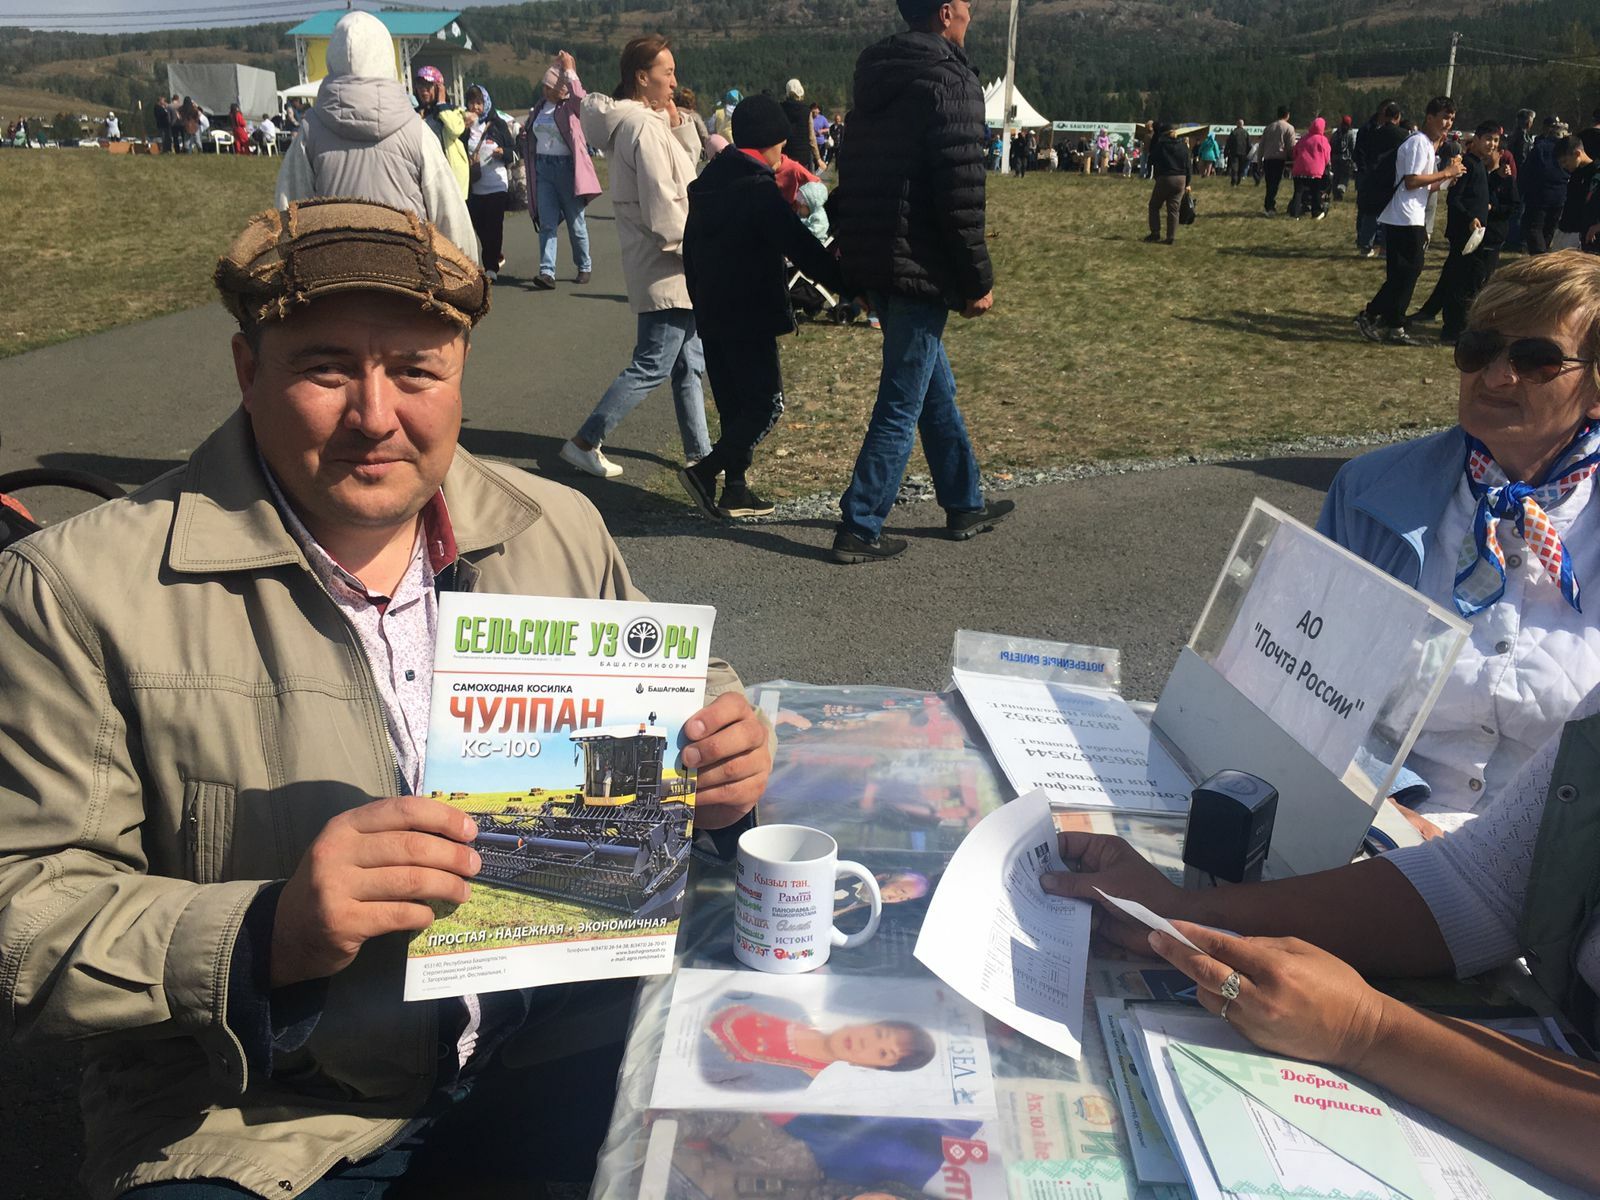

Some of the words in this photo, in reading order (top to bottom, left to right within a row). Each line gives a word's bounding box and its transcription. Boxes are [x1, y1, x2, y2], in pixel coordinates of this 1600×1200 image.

[1296, 610, 1324, 640] АО
[454, 615, 580, 656] СЕЛЬСКИЕ
[599, 661, 688, 670] БАШАГРОИНФОРМ
[1000, 651, 1040, 665] БИЛЕТЫ
[1041, 655, 1105, 673] ЛОТЕРЕЙНЫЕ
[1254, 622, 1298, 675] "Почта
[1296, 660, 1365, 719] России"
[452, 682, 524, 693] САМОХОДНАЯ
[526, 684, 573, 694] КОСИЛКА
[449, 695, 605, 735] ЧУЛПАН
[460, 738, 541, 759] КС-100
[1045, 771, 1125, 785] перевода
[1127, 777, 1158, 788] для
[1031, 780, 1107, 795] телефон
[1109, 785, 1189, 801] Сотовый
[428, 930, 486, 947] ПРОСТАЯ
[495, 923, 565, 940] НАДЕЖНАЯ
[578, 917, 668, 933] ЭКОНОМИЧНАЯ
[775, 935, 814, 945] ИСТОКИ
[1280, 1067, 1350, 1092] Добрая
[1293, 1093, 1383, 1117] подписка
